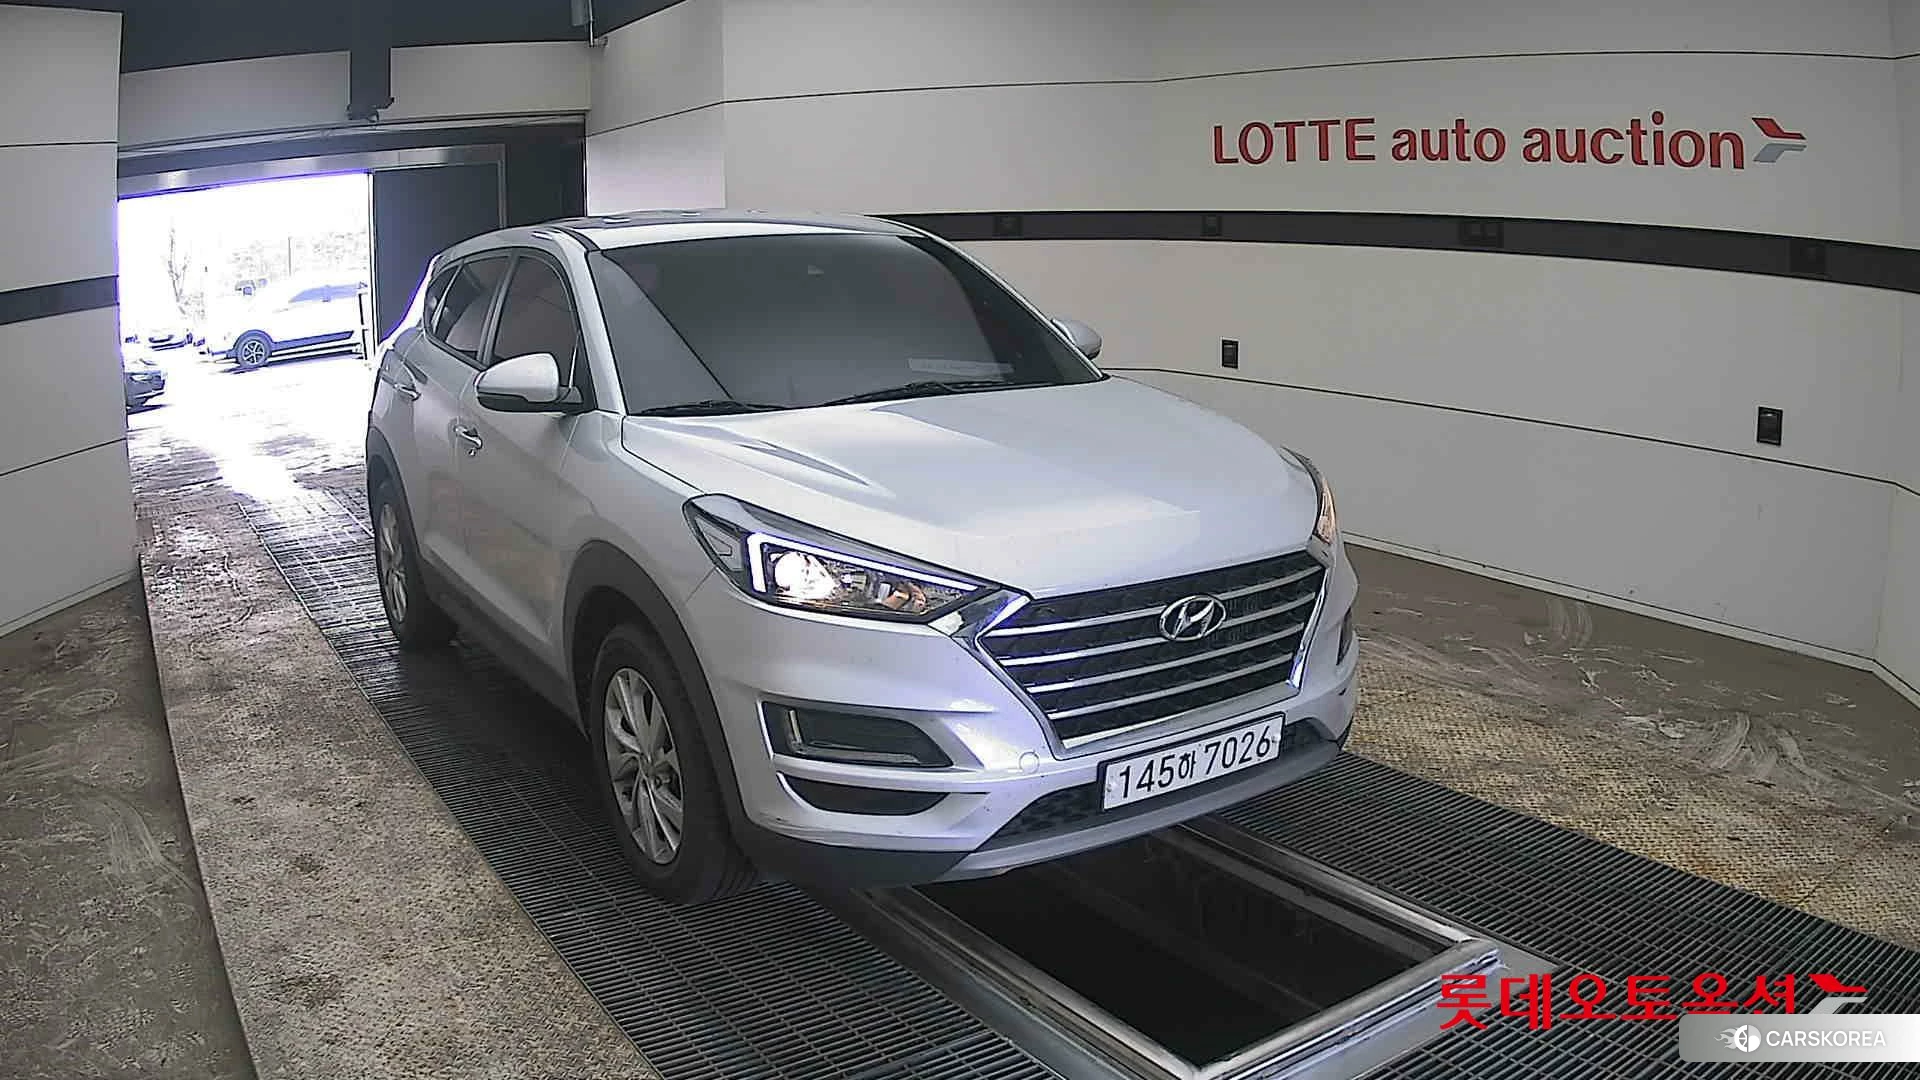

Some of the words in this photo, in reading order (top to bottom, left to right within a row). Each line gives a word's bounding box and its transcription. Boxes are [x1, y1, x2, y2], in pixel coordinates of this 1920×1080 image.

[1212, 117, 1376, 165] LOTTE
[1391, 117, 1507, 162] auto
[1522, 110, 1746, 170] auction
[1204, 725, 1271, 775] 7026
